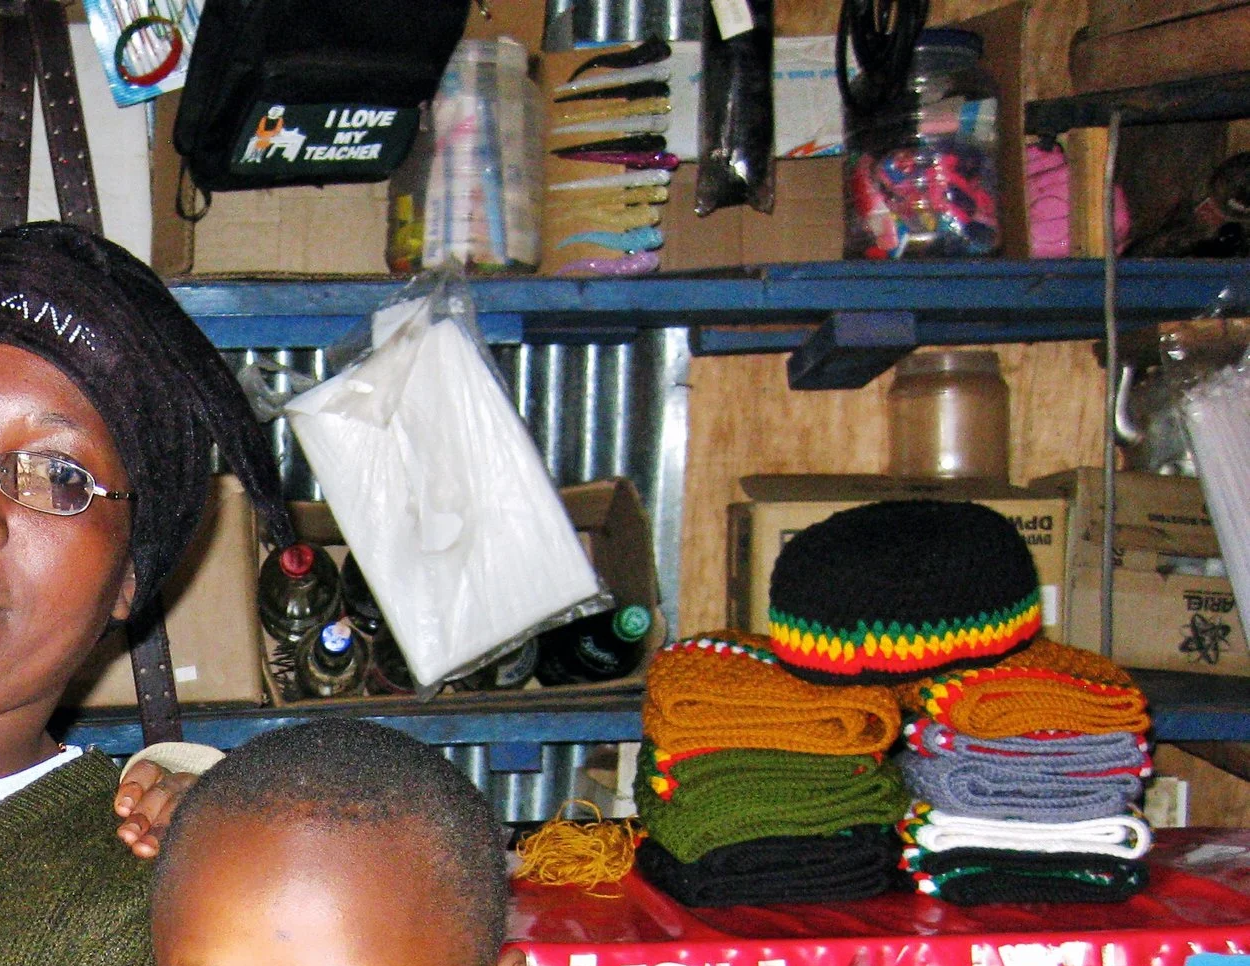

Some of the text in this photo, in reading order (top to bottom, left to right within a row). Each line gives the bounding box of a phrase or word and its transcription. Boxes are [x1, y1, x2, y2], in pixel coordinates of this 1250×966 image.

[324, 108, 398, 129] I LOVE
[333, 130, 368, 144] MY
[303, 142, 383, 160] TEACHER
